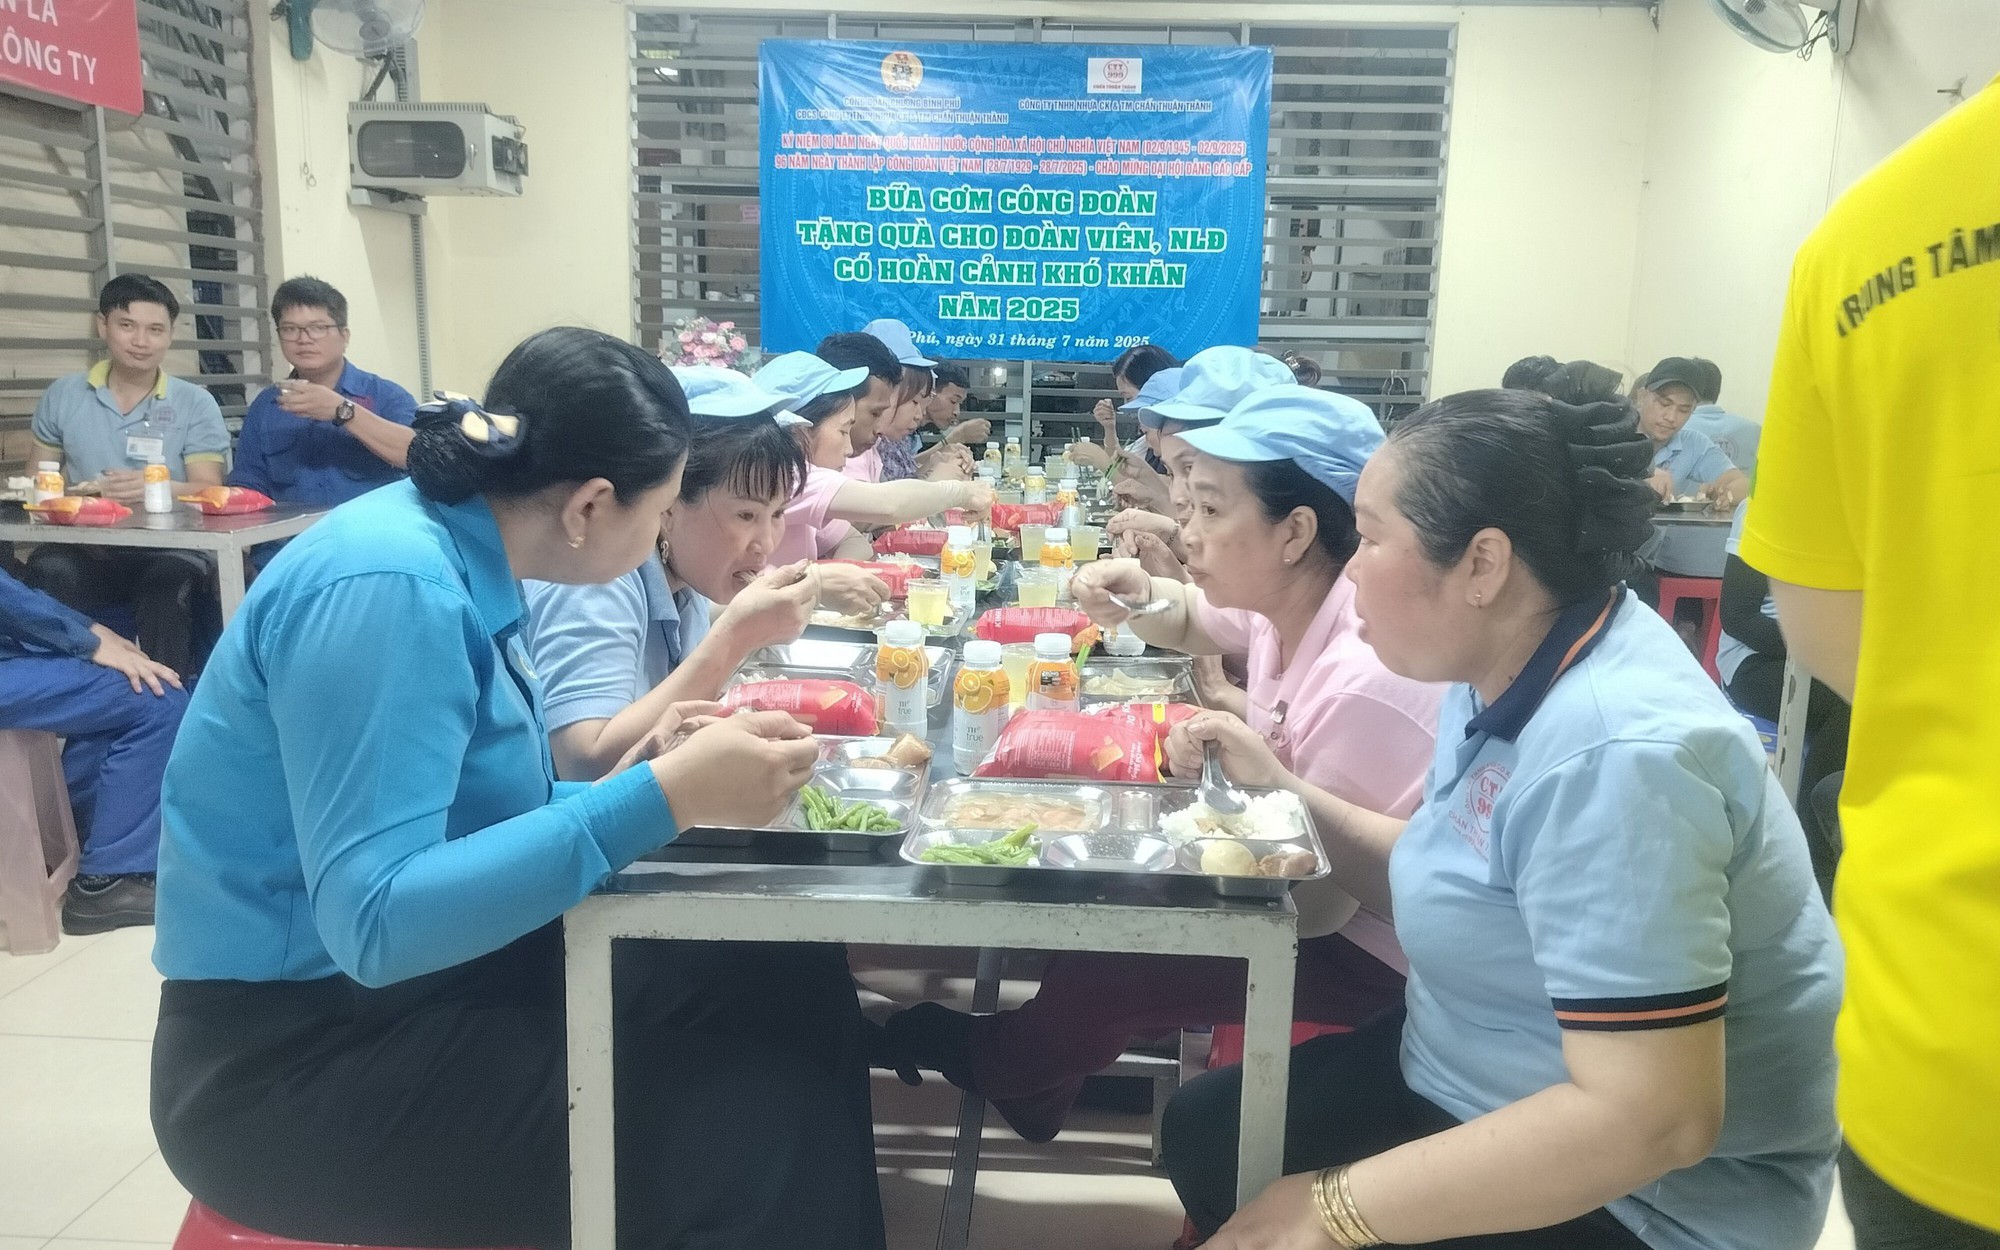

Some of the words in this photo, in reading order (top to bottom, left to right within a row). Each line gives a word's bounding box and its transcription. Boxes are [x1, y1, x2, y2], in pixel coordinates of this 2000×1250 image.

[0, 25, 62, 76] ÔNG
[67, 49, 97, 85] TY
[1107, 63, 1123, 71] CTT
[1107, 71, 1124, 79] 999
[923, 96, 942, 109] BÌNH
[1019, 98, 1041, 110] CÔNG
[1042, 100, 1053, 110] TY
[1054, 100, 1075, 111] TNHH
[1076, 99, 1098, 113] NHỰA
[1099, 100, 1111, 111] CK
[1112, 100, 1120, 111] &
[1120, 100, 1134, 111] TM
[1134, 98, 1156, 112] CHẤN
[1158, 99, 1184, 113] THUẬN
[1185, 99, 1212, 112] THÀNH
[955, 111, 981, 125] THUẬN
[982, 111, 1008, 124] THÀNH
[796, 131, 820, 151] NIỆM
[822, 133, 833, 149] 80
[834, 132, 856, 149] NĂM
[909, 134, 940, 151] KHÁNH
[968, 135, 994, 155] CỘNG
[1029, 135, 1045, 156] HỘI
[1067, 137, 1095, 154] NGHĨA
[1096, 137, 1117, 157] VIỆT
[1118, 139, 1140, 154] NAM
[1142, 140, 1191, 156] (02/9/1945
[1198, 140, 1246, 157] 02/9/2025)
[775, 154, 787, 169] 96
[788, 152, 810, 169] NĂM
[811, 153, 836, 170] NGÀY
[837, 153, 866, 170] THÀNH
[867, 154, 885, 173] LẬP
[887, 154, 912, 171] CÔNG
[940, 155, 960, 175] VIỆT
[961, 157, 983, 173] NAM
[984, 157, 1033, 175] (28/7/1929
[1039, 159, 1088, 176] 28/7/2025)
[1095, 157, 1120, 175] CHÀO
[1168, 159, 1184, 179] HỘI
[1213, 159, 1232, 177] CÁC
[868, 183, 924, 210] BỮA
[931, 185, 991, 212] CƠM
[1000, 185, 1073, 214] CÔNG
[1080, 185, 1156, 214] ĐOÀN
[797, 217, 872, 249] TẶNG
[880, 218, 935, 249] QUÀ
[941, 225, 997, 248] CHO
[1004, 220, 1079, 250] ĐOÀN
[1086, 223, 1161, 254] VIÊN,
[1168, 228, 1227, 252] NLĐ
[1926, 222, 2000, 278] TÂM
[835, 253, 872, 281] CÓ
[878, 254, 953, 283] HOÀN
[961, 254, 1036, 285] CẢNH
[1043, 256, 1101, 286] KHÓ
[1108, 259, 1186, 287] KHĂN
[939, 292, 1000, 319] NĂM
[1007, 298, 1079, 321] 2025
[909, 329, 940, 345] Phú,
[945, 332, 982, 347] ngày
[987, 333, 1005, 346] 31
[1010, 334, 1056, 349] tháng
[1062, 335, 1071, 347] 7
[1074, 335, 1110, 348] năm
[1113, 336, 1150, 349] 2025
[966, 733, 984, 742] true
[1480, 775, 1503, 799] CT
